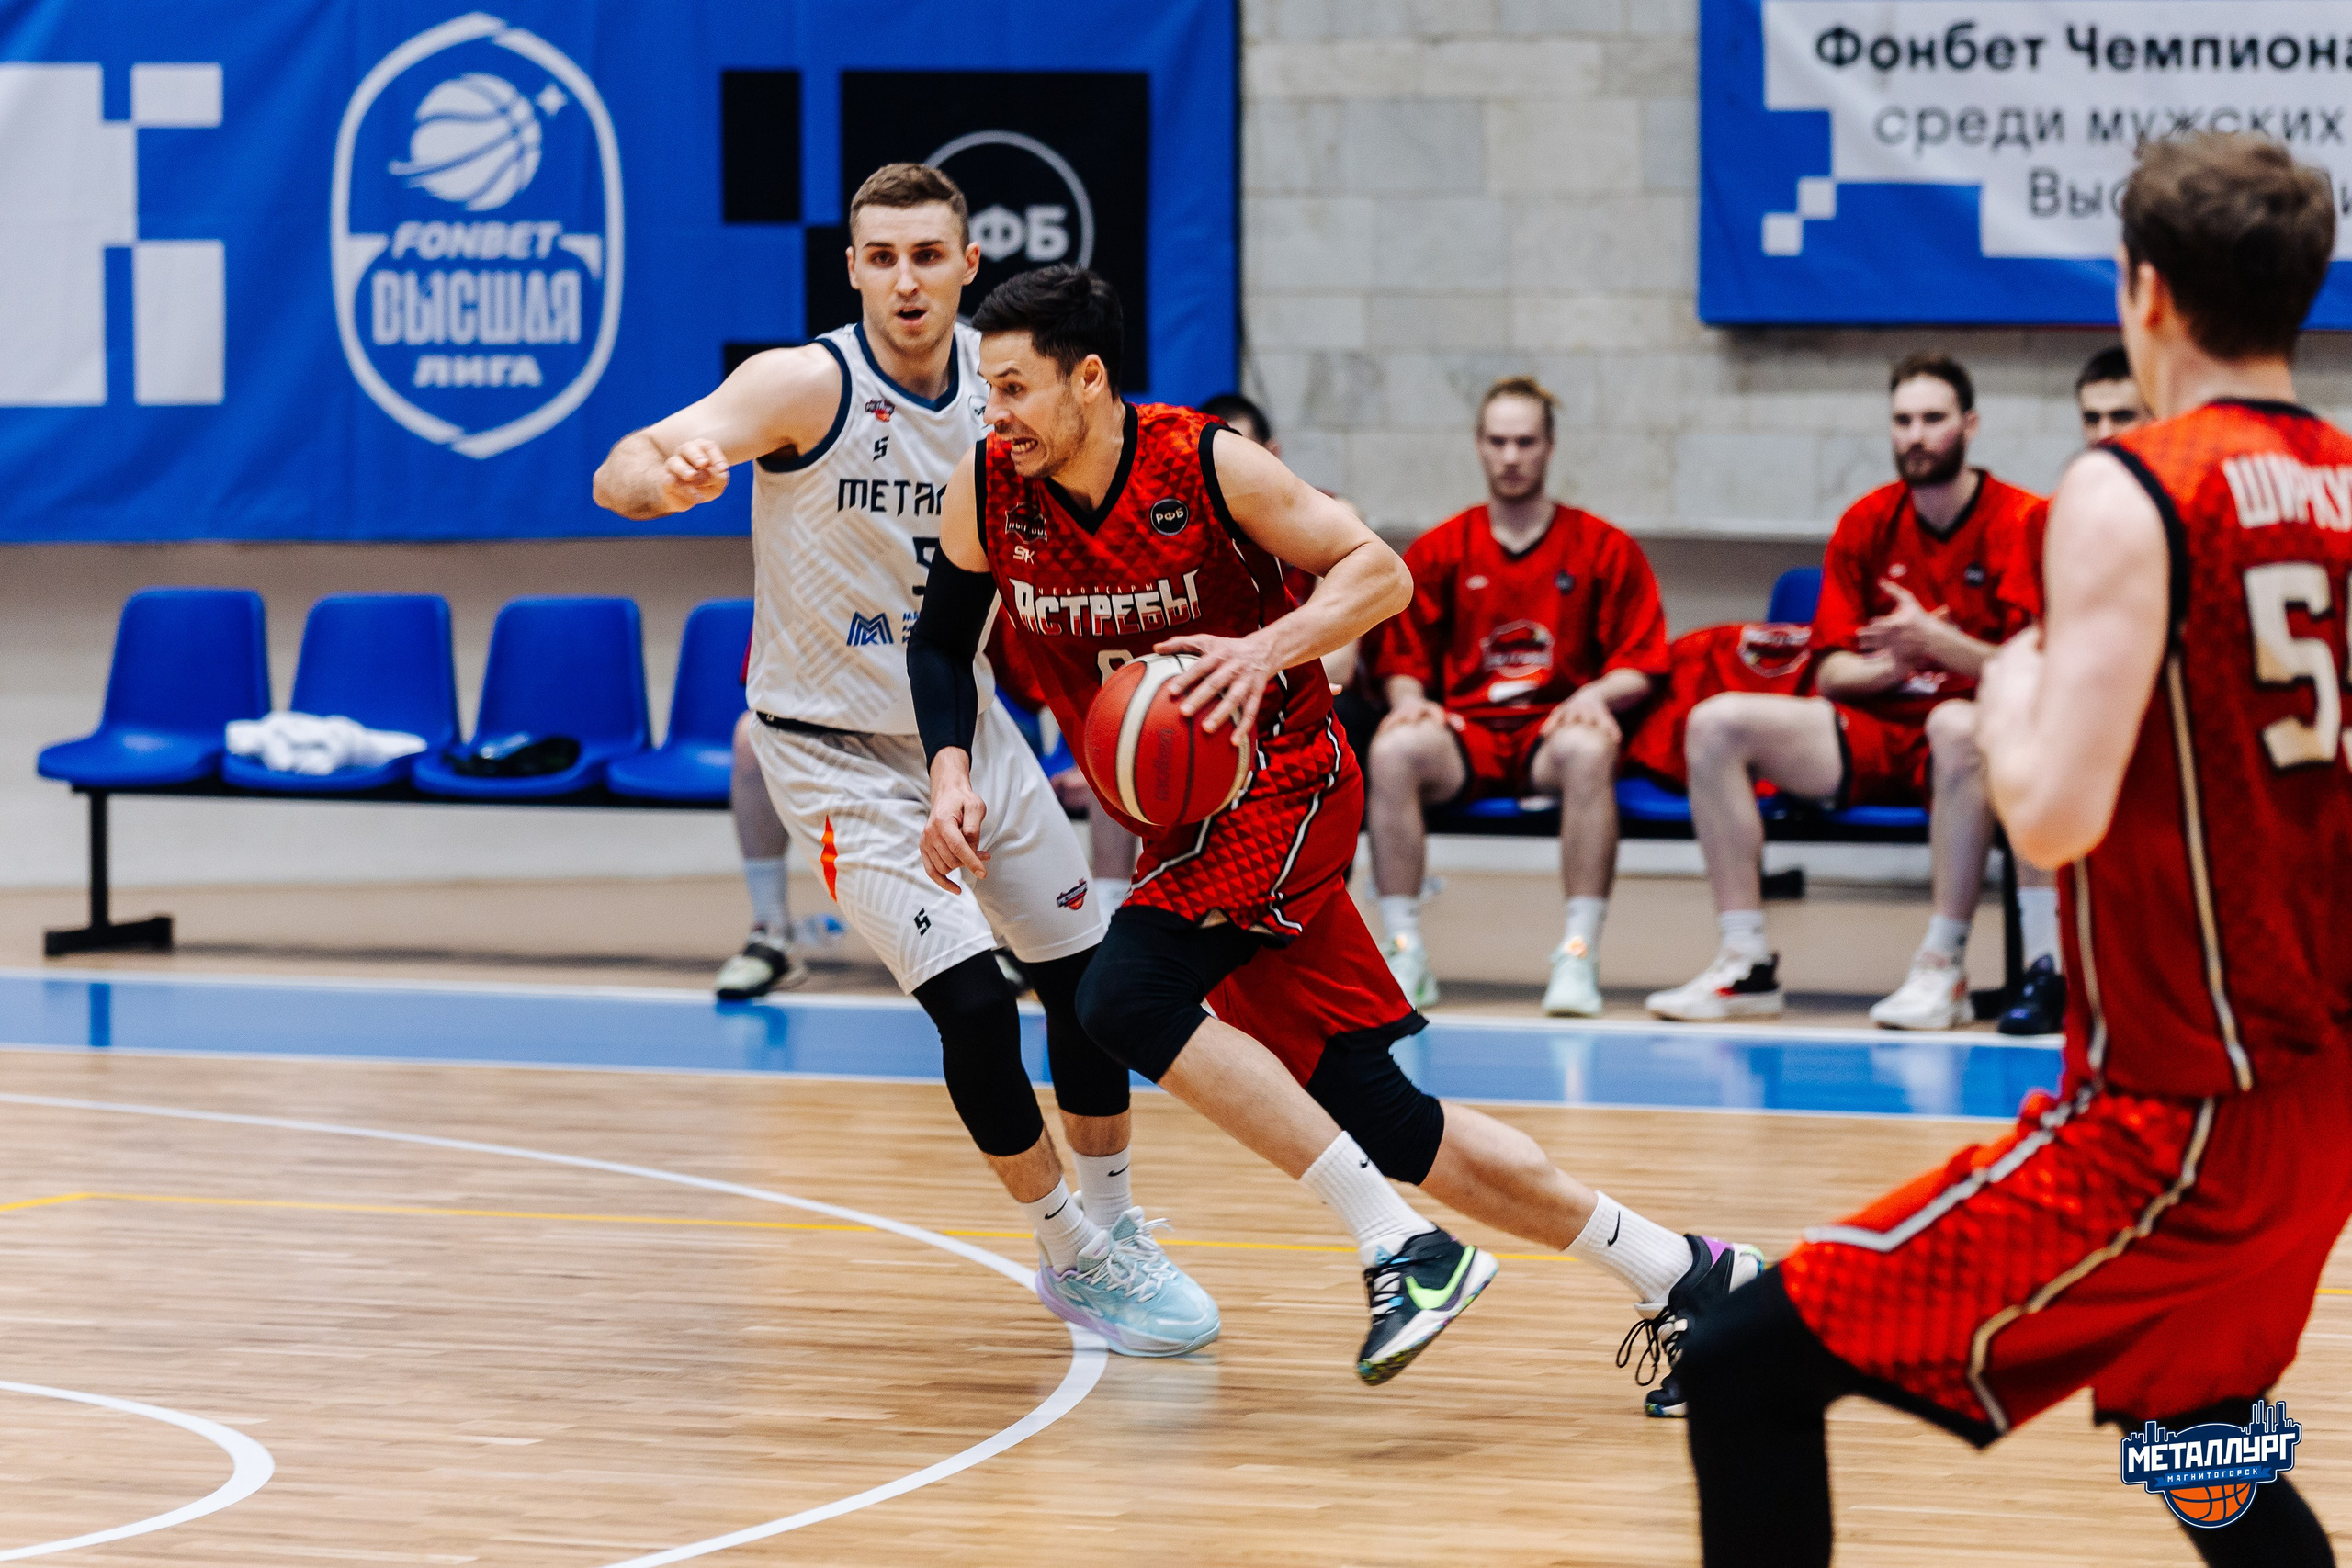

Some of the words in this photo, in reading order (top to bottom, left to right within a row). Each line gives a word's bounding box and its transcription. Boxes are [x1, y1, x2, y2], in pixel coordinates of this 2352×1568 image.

[1815, 21, 2045, 71] Фонбет
[1874, 106, 2065, 157] среди
[391, 220, 563, 260] FONBET
[968, 204, 1069, 262] ФБ
[371, 269, 582, 345] ВЫСШАЯ
[413, 354, 544, 389] ЛИГА
[1155, 507, 1185, 525] РФБ
[2243, 559, 2352, 769] 5
